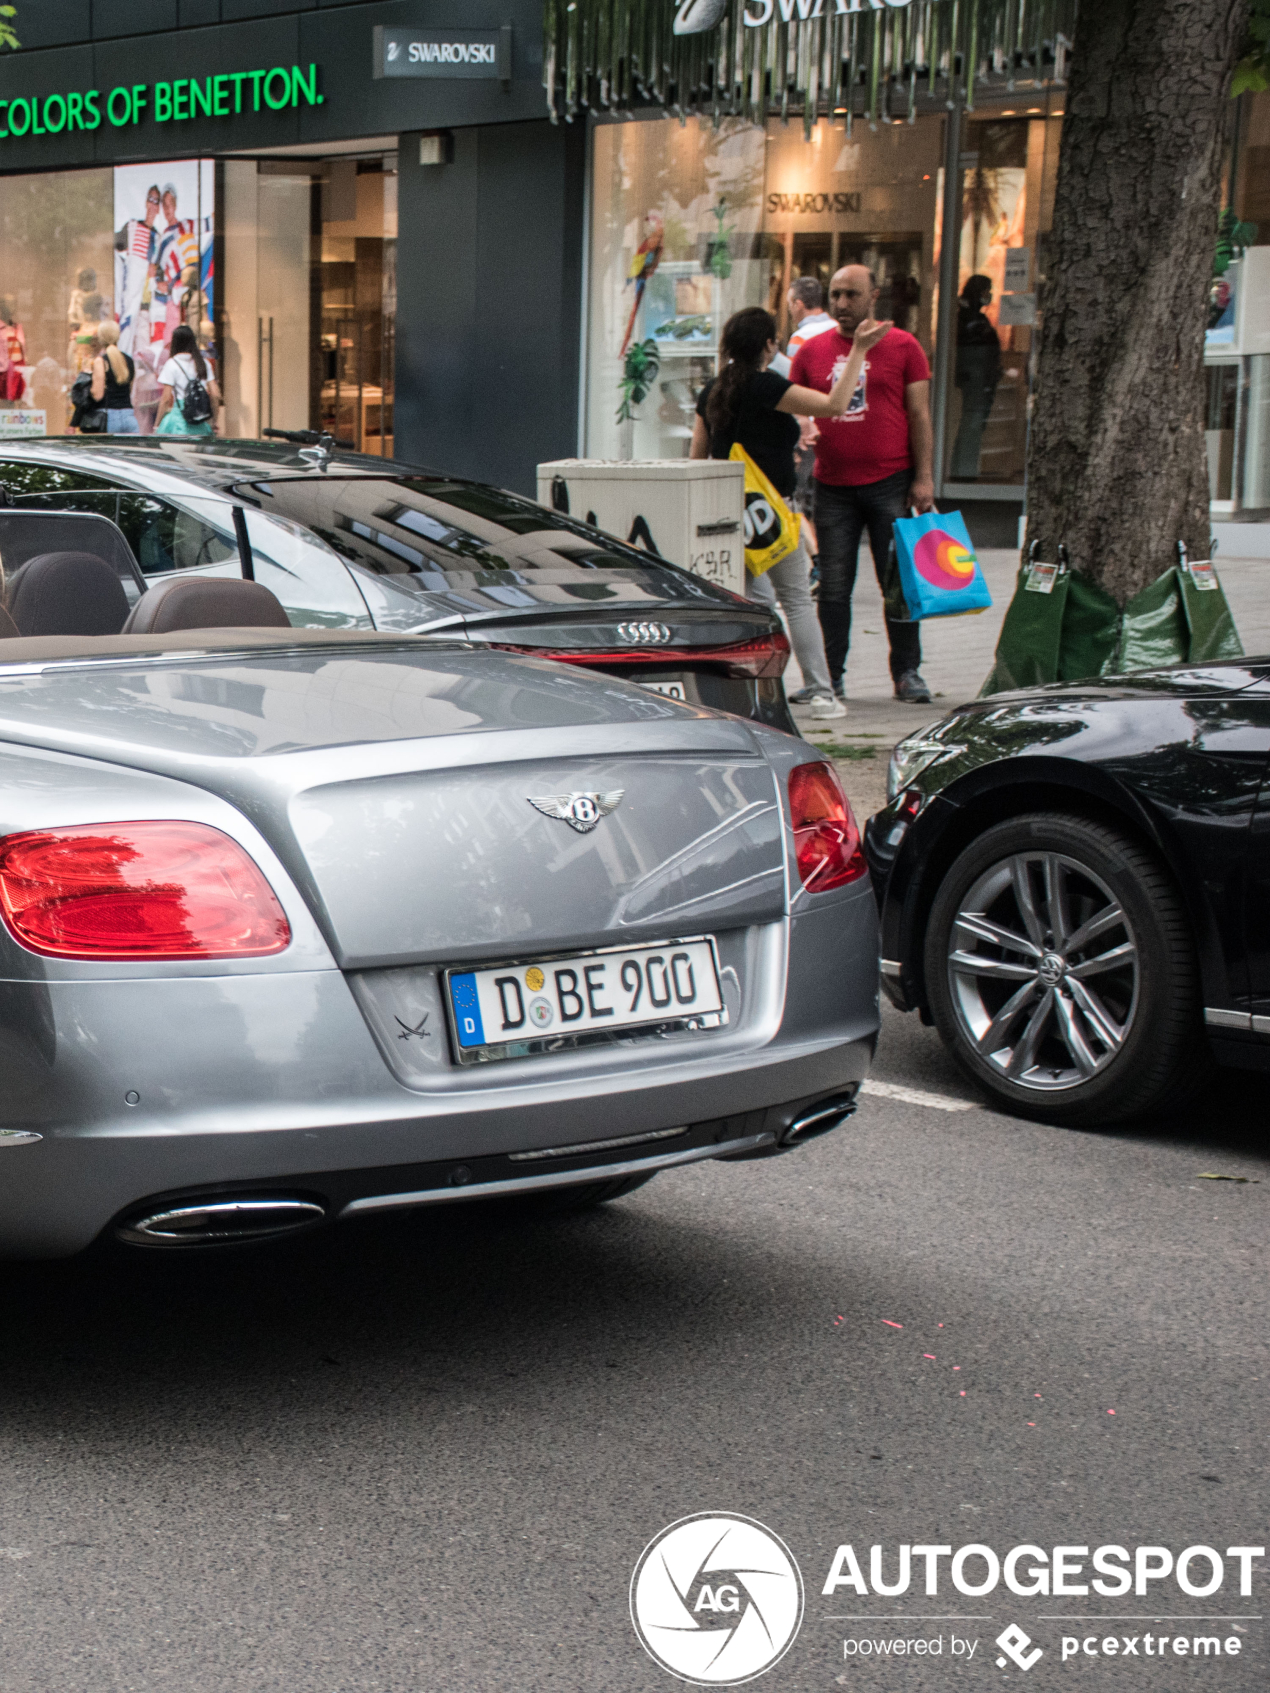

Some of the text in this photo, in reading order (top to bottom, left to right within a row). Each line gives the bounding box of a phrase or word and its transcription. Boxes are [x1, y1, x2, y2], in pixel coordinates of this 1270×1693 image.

[408, 42, 495, 63] SWAROVSKI
[107, 84, 147, 127] OF
[154, 63, 324, 122] BENETTON.
[767, 193, 861, 213] SWAROVSKI
[2, 411, 44, 425] rainbows
[494, 953, 697, 1030] D BE 900
[464, 1017, 476, 1034] D
